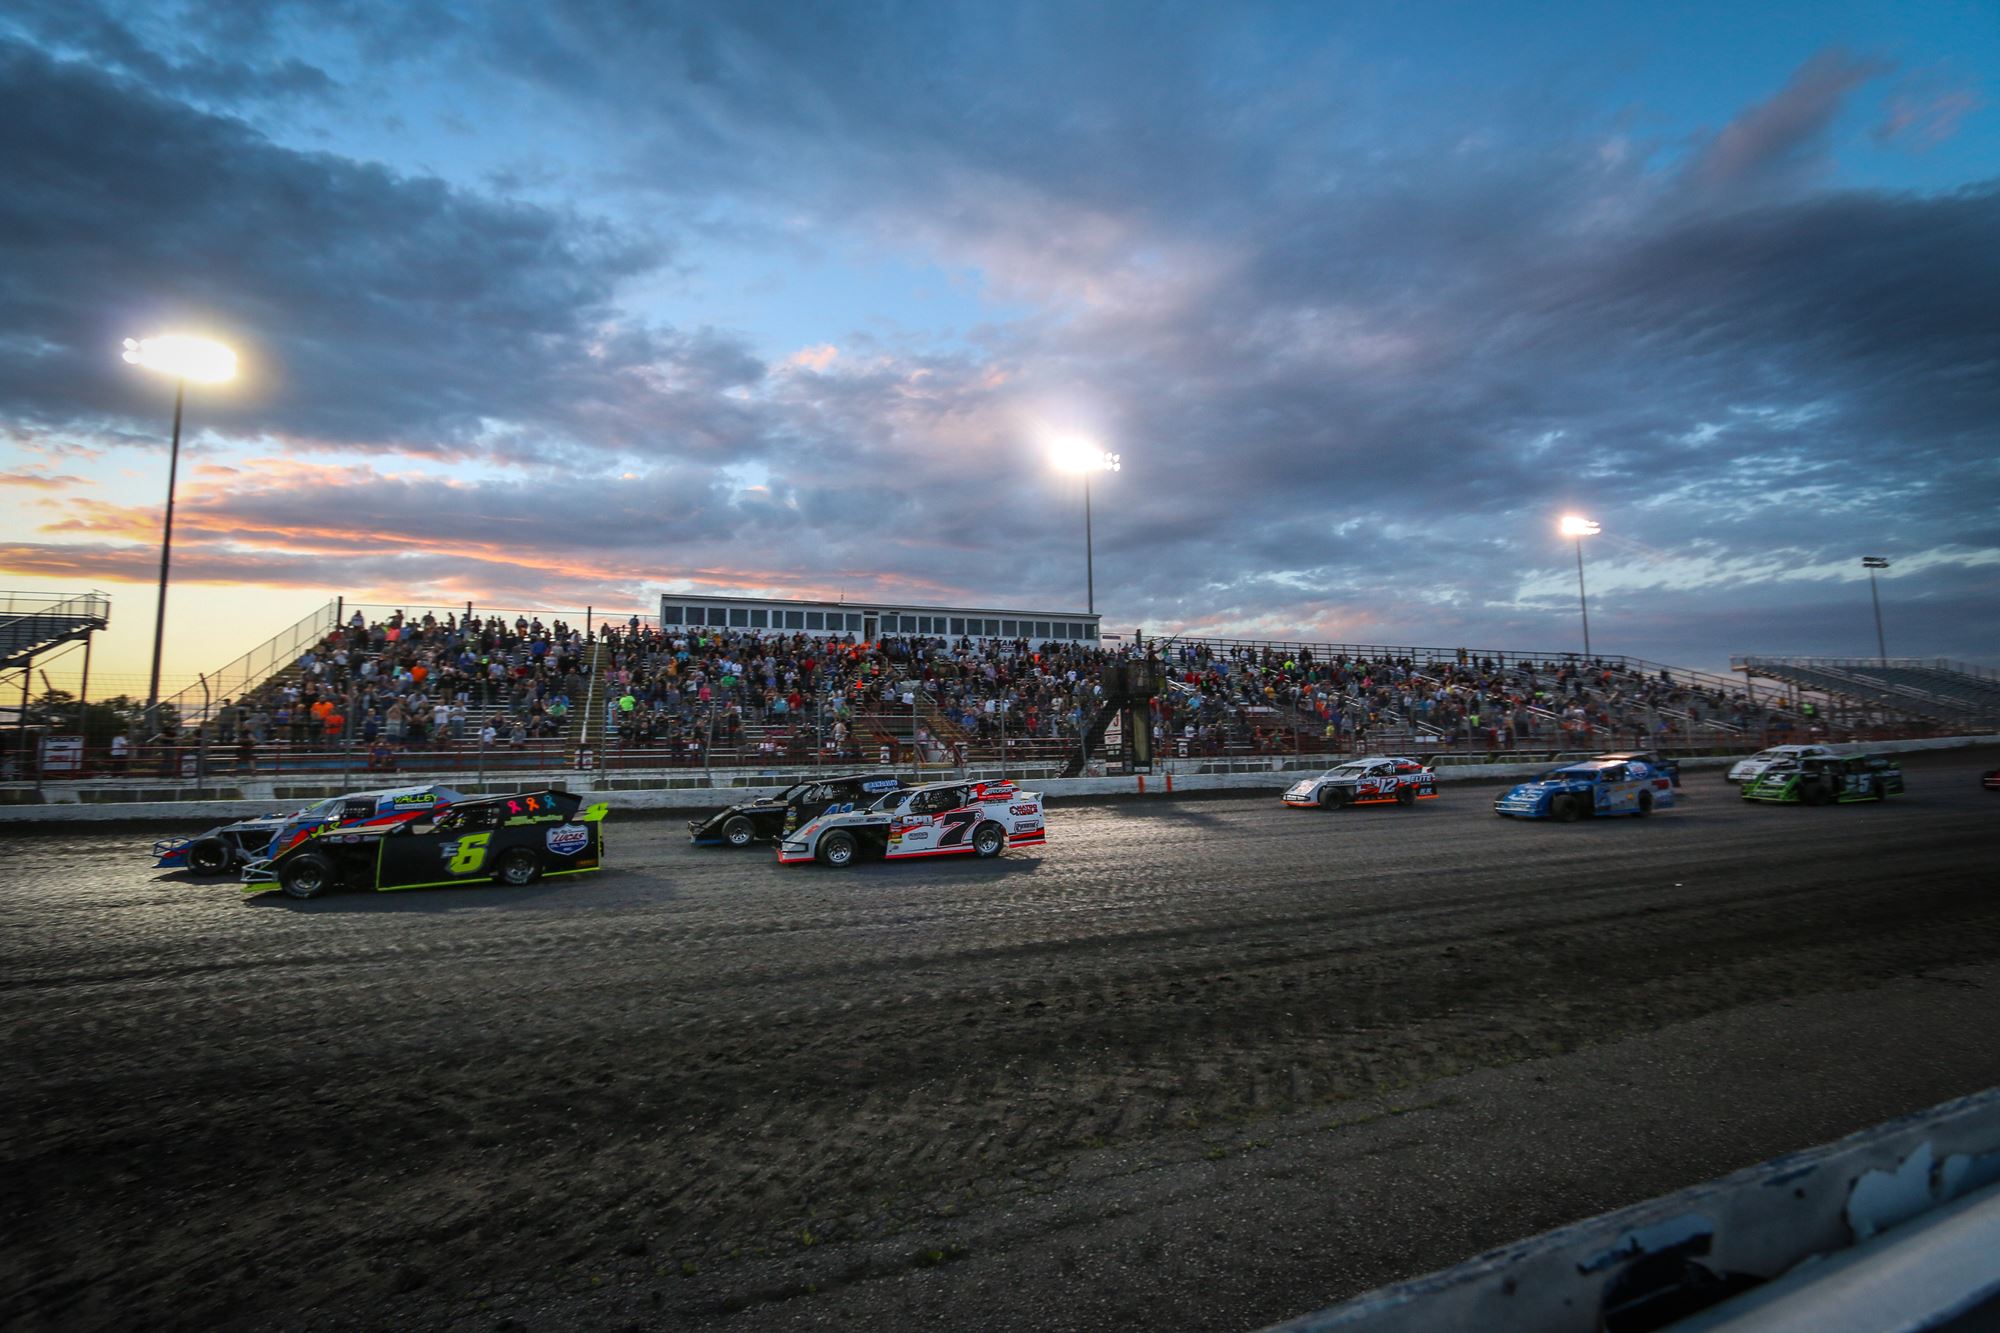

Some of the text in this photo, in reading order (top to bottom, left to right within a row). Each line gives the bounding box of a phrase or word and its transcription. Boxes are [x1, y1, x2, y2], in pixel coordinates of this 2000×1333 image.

[1379, 777, 1399, 794] 12
[393, 794, 437, 804] VALLEY
[552, 832, 585, 842] LUCAS
[938, 810, 980, 848] 7
[449, 833, 491, 873] 6
